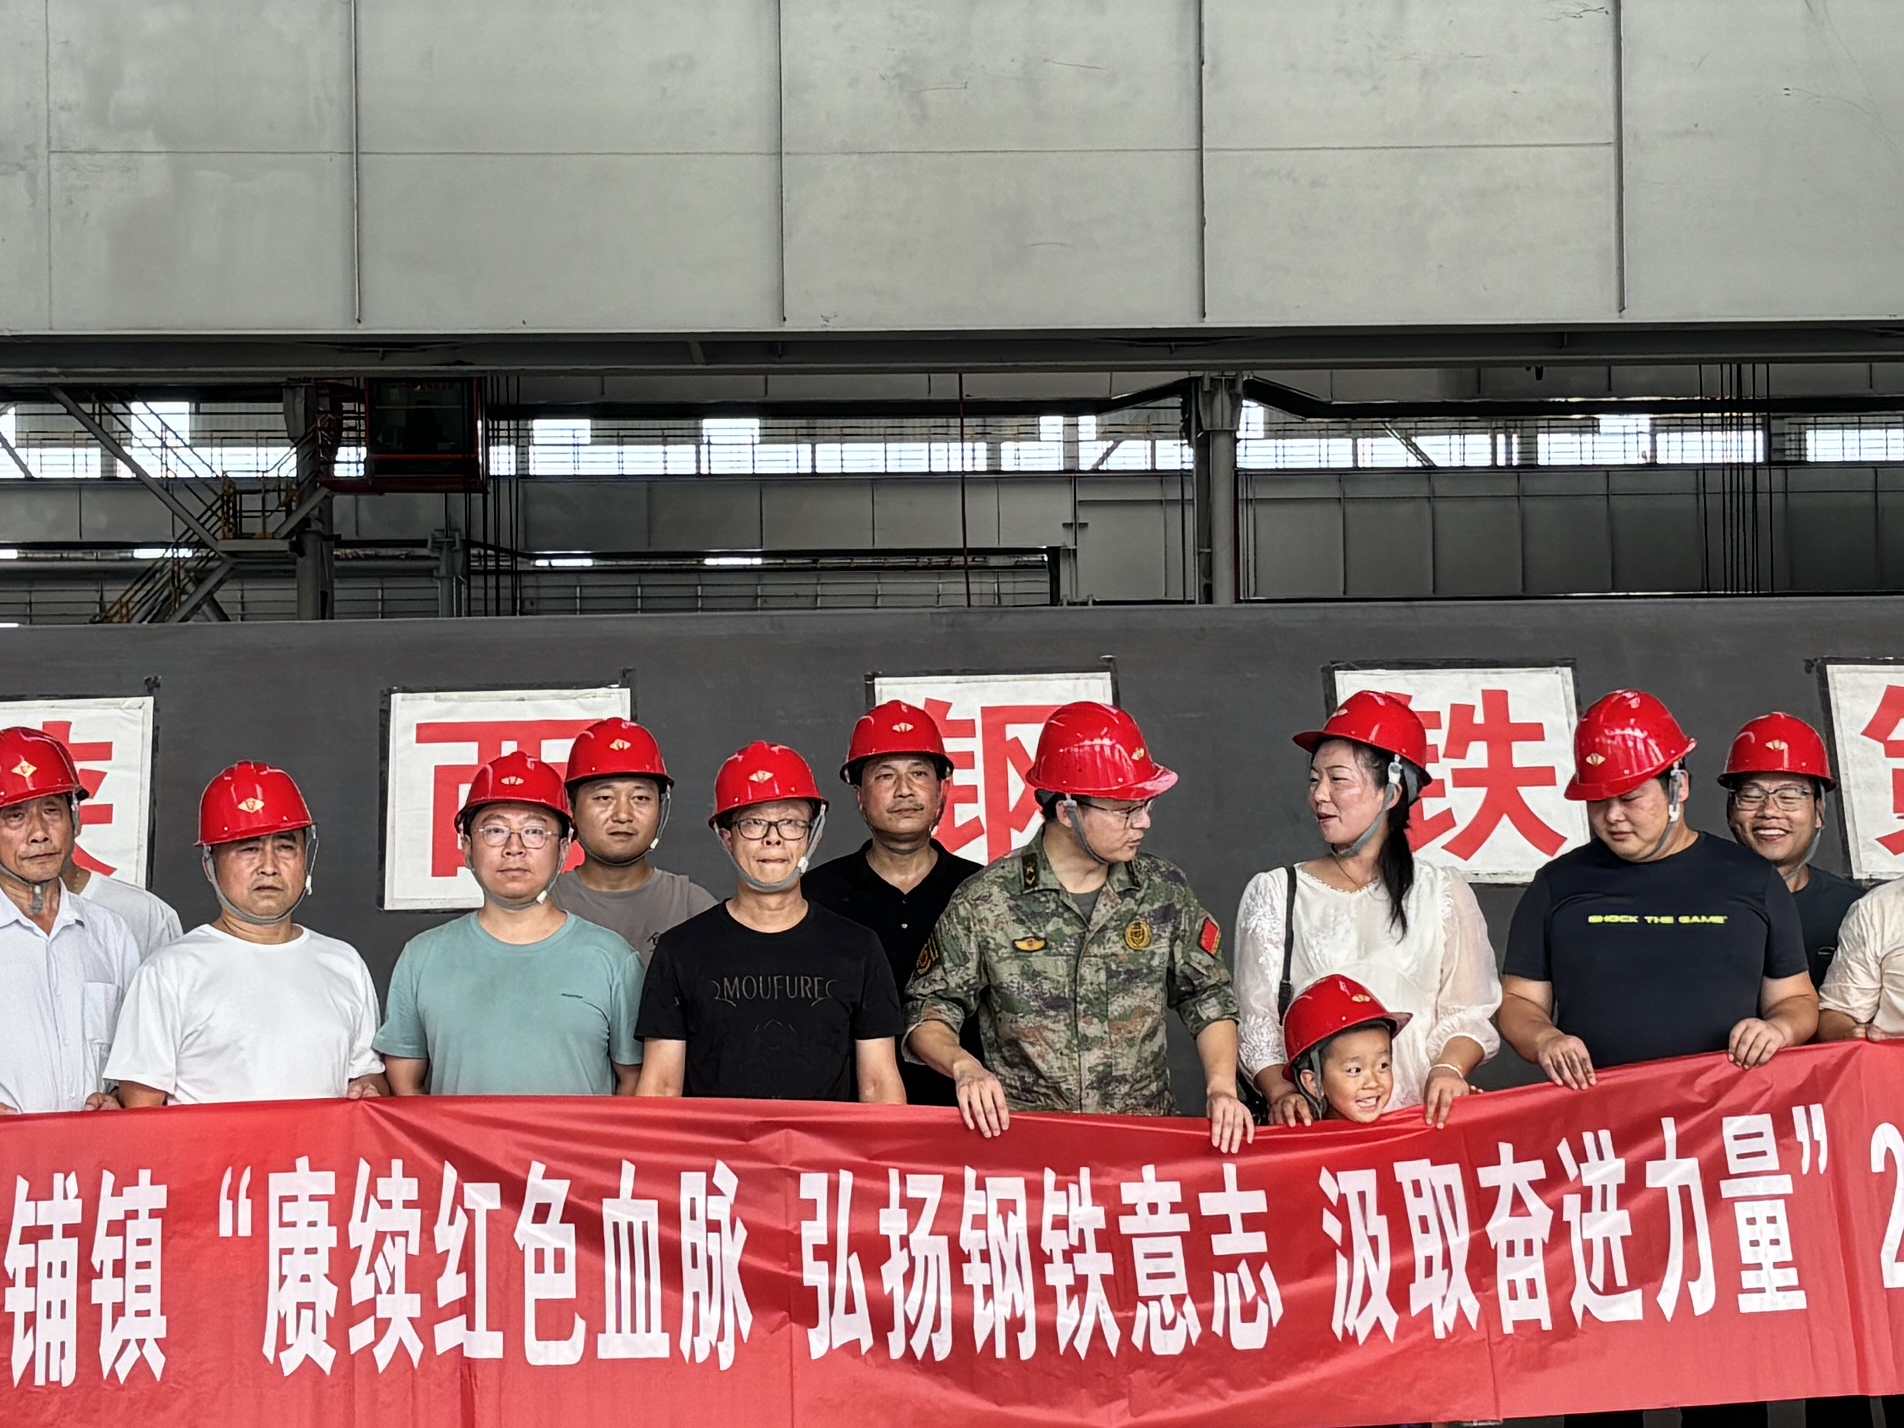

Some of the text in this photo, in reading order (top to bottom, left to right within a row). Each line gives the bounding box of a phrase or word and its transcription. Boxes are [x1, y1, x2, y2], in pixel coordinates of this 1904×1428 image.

[218, 1155, 754, 1377] “赓续红色血脉
[798, 1162, 1285, 1361] 弘扬钢铁意志
[1318, 1103, 1829, 1345] 汲取奋进力量”
